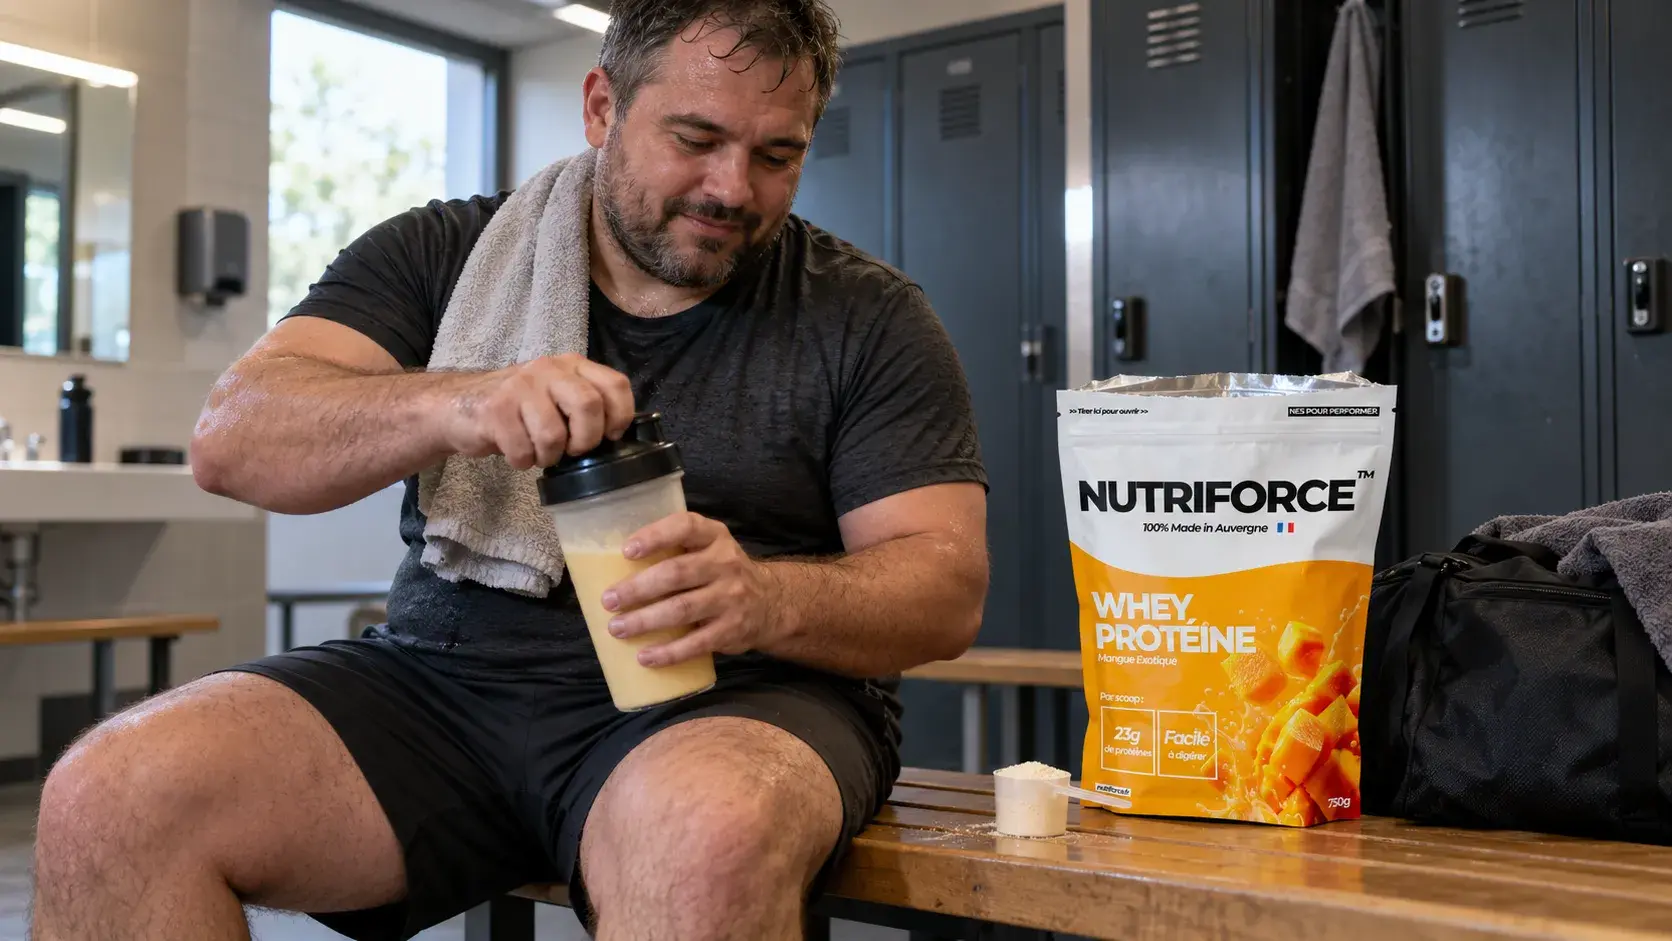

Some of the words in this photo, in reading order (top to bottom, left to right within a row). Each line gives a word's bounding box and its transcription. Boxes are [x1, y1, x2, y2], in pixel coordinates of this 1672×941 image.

[1101, 408, 1119, 416] pour
[1079, 479, 1356, 514] NUTRIFORCE
[1143, 523, 1169, 533] 100%
[1170, 523, 1202, 533] Made
[1203, 523, 1214, 533] in
[1214, 524, 1269, 535] Auvergne
[1091, 591, 1194, 621] WHEY
[1096, 619, 1257, 654] PROTÉINE
[1098, 654, 1135, 665] Mangue
[1136, 655, 1178, 667] Exotique
[1100, 692, 1114, 701] Par
[1115, 694, 1140, 704] scoop
[1114, 726, 1140, 745] 23g
[1164, 728, 1210, 746] Facile
[1104, 745, 1114, 753] de
[1168, 750, 1174, 759] à
[1328, 797, 1350, 808] 750g
